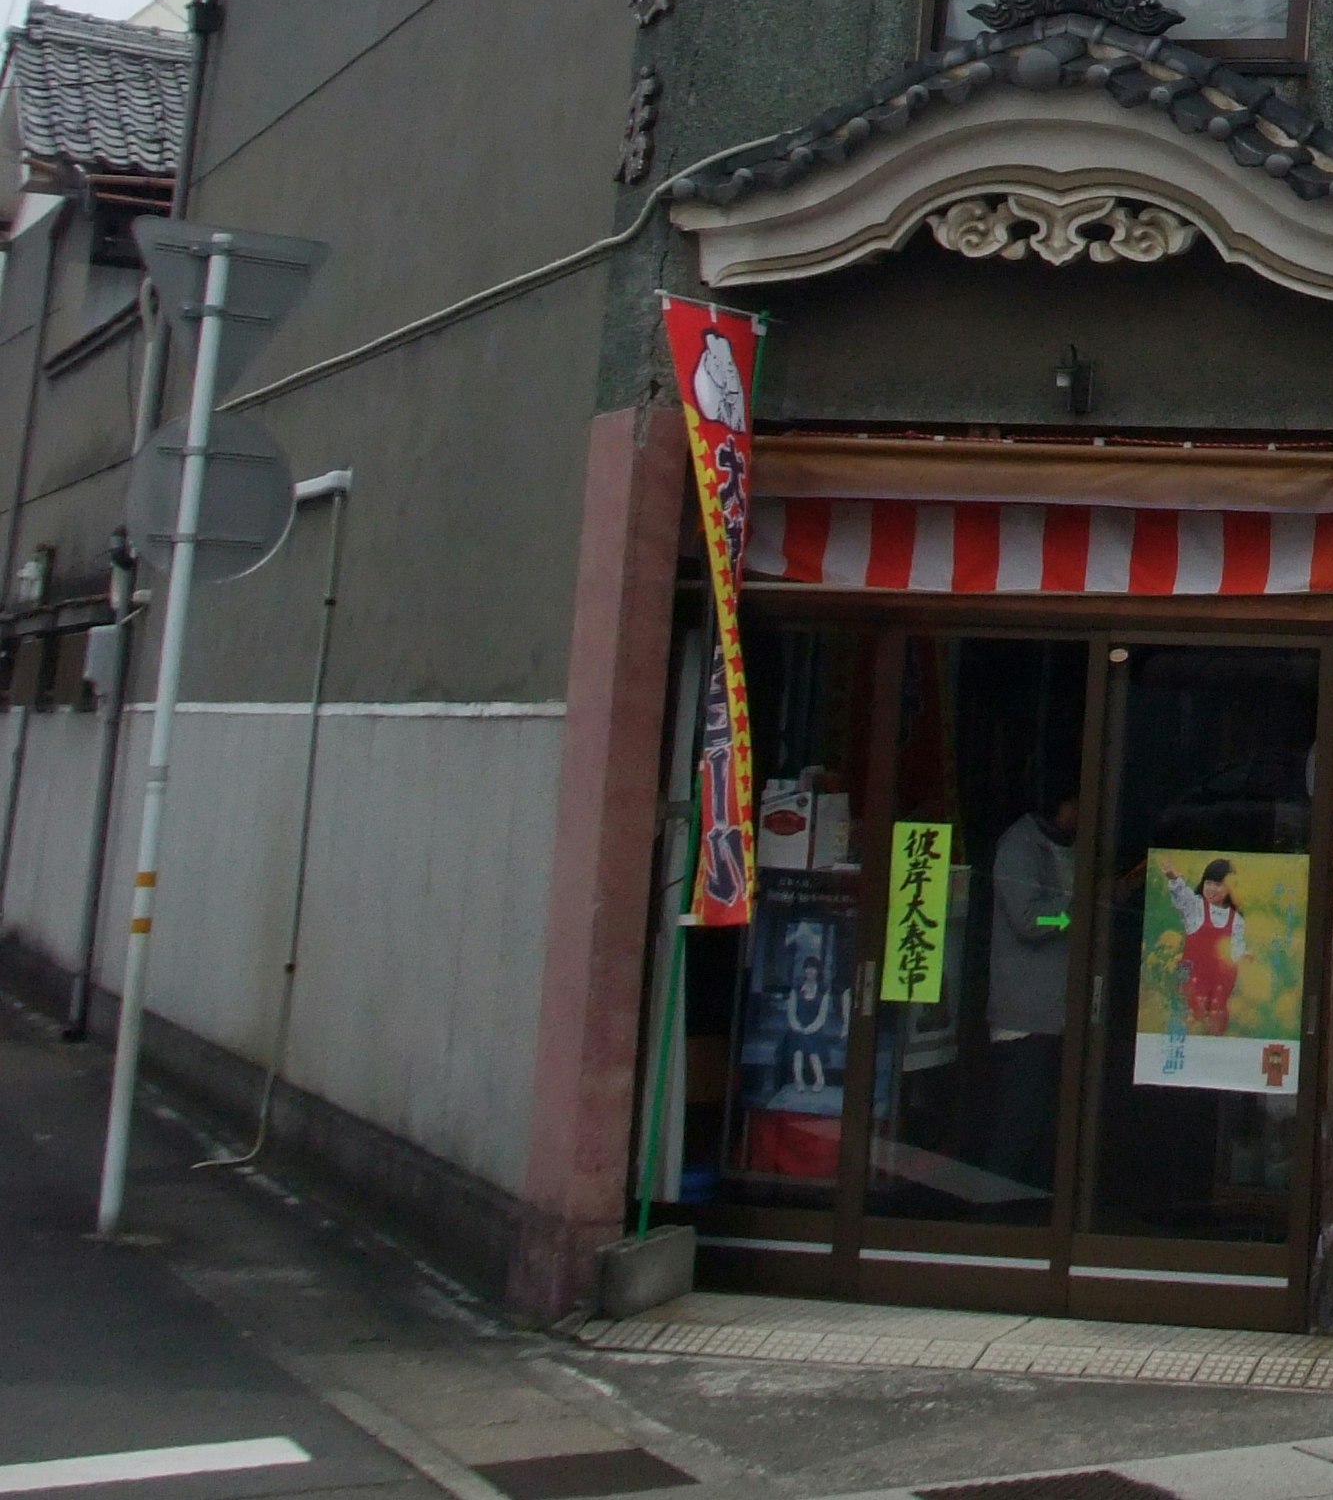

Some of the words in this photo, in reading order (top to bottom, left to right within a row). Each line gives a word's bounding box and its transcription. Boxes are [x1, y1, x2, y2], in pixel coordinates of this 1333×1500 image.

[898, 828, 942, 1003] 彼岸大奉仕中
